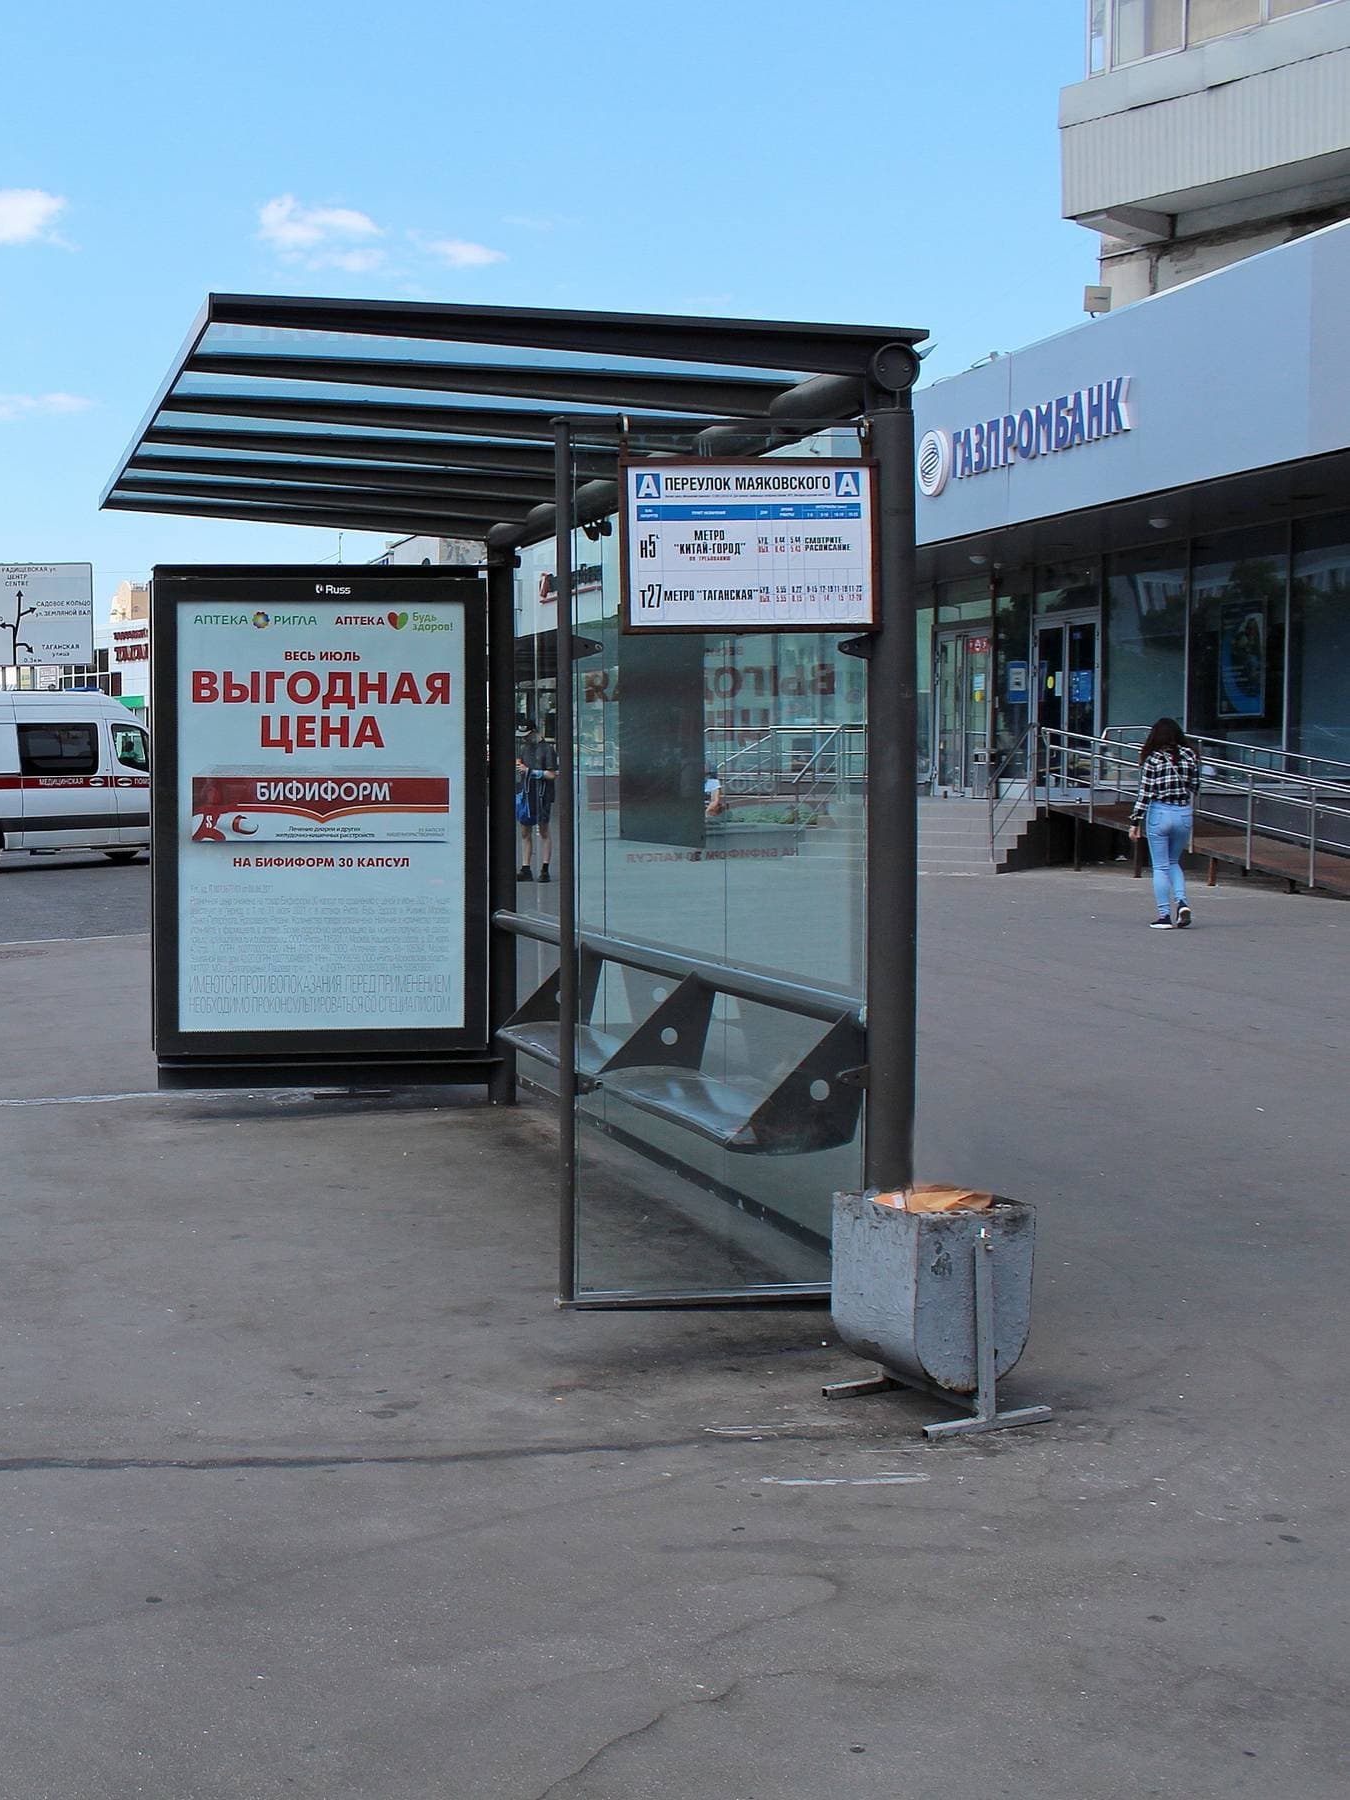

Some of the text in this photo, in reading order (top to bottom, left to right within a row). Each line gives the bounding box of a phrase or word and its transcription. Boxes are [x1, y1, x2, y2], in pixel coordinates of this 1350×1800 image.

[952, 376, 1133, 479] ГАЗПРОМБАНК
[665, 477, 730, 491] ПЕРЕУЛОК
[735, 476, 830, 490] МАЯКОВСКОГО
[694, 530, 725, 541] МЕТРО
[804, 536, 843, 544] СМОТРИТЕ
[325, 584, 351, 595] Russ
[664, 590, 695, 601] МЕТРО
[193, 615, 318, 626] АПТЕКА РИГЛА
[335, 616, 385, 626] АПТЕКА
[412, 611, 437, 623] Будь
[412, 622, 454, 632] здоров!
[284, 651, 361, 661] ВЕСЬ ИЮЛЬ
[192, 670, 452, 710] ВЫГОДНАЯ
[260, 715, 385, 753] ЦЕНА
[38, 778, 84, 786] МЕДИЦИНСКАЯ
[256, 780, 391, 801] БИФИФОРМ
[233, 857, 410, 868] НА БИФИФОРМ 30 КАПСУЛ
